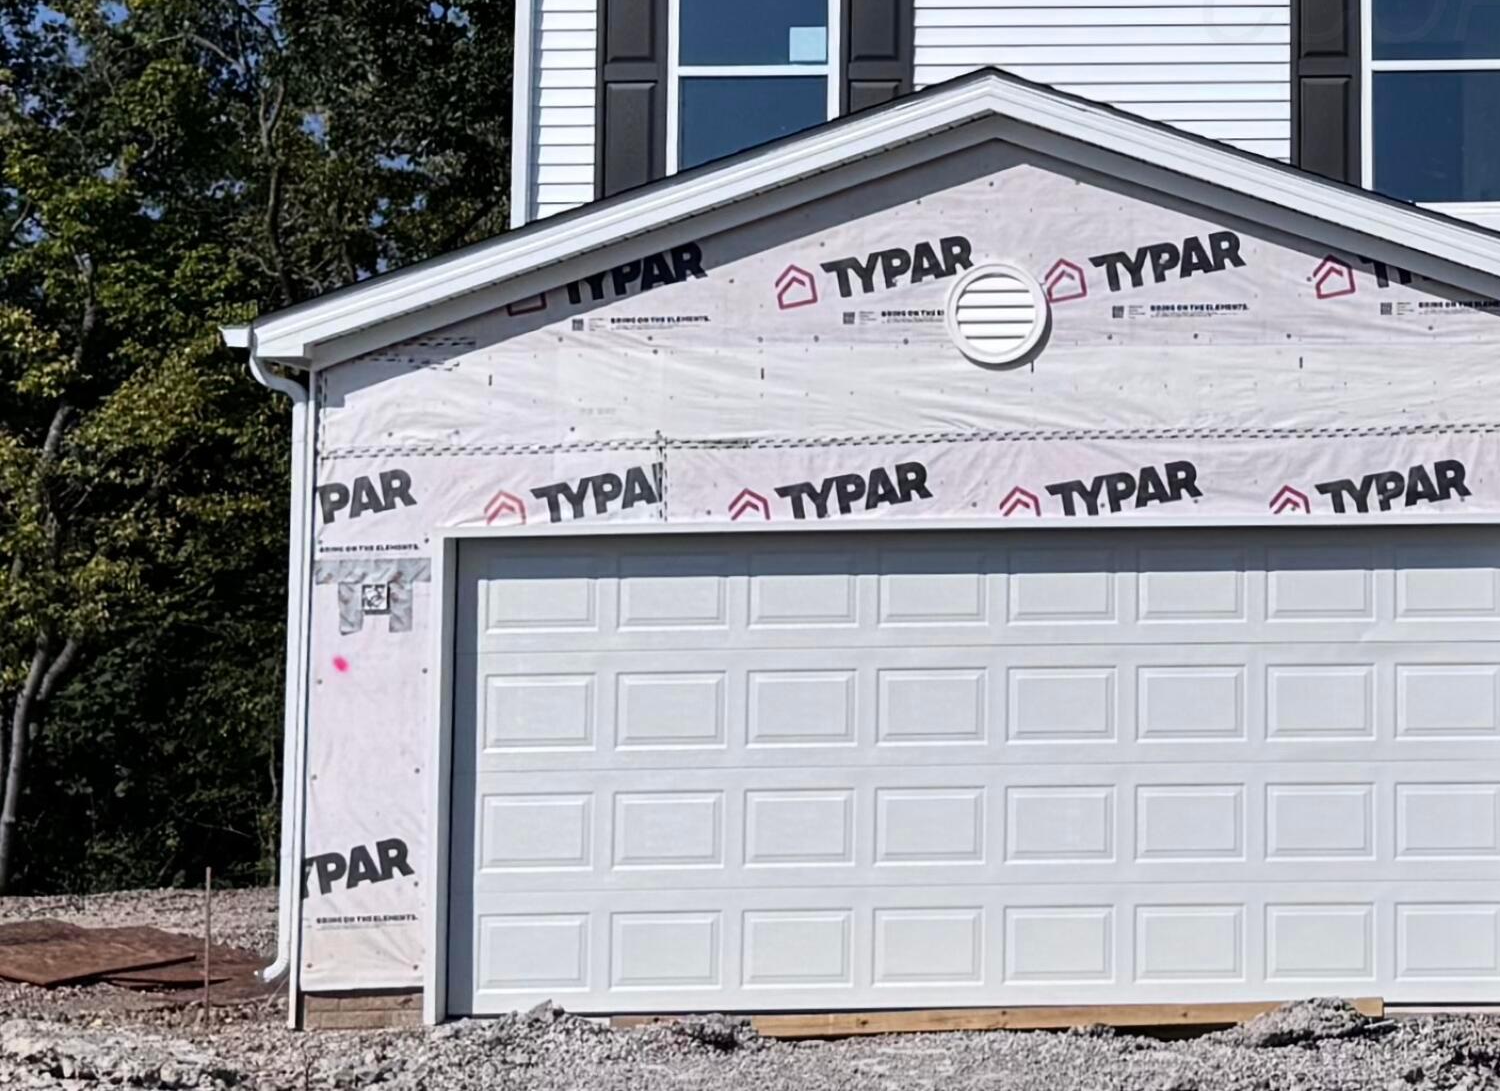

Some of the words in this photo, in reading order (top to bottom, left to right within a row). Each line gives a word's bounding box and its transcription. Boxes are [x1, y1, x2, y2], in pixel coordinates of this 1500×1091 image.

[820, 236, 974, 298] TYPAR
[1088, 231, 1247, 292] TYPAR
[317, 468, 418, 525] PAR
[529, 461, 663, 524] TYPA
[774, 461, 935, 520] TYPAR
[1044, 459, 1203, 516] TYPAR
[1314, 459, 1471, 514] TYPAR
